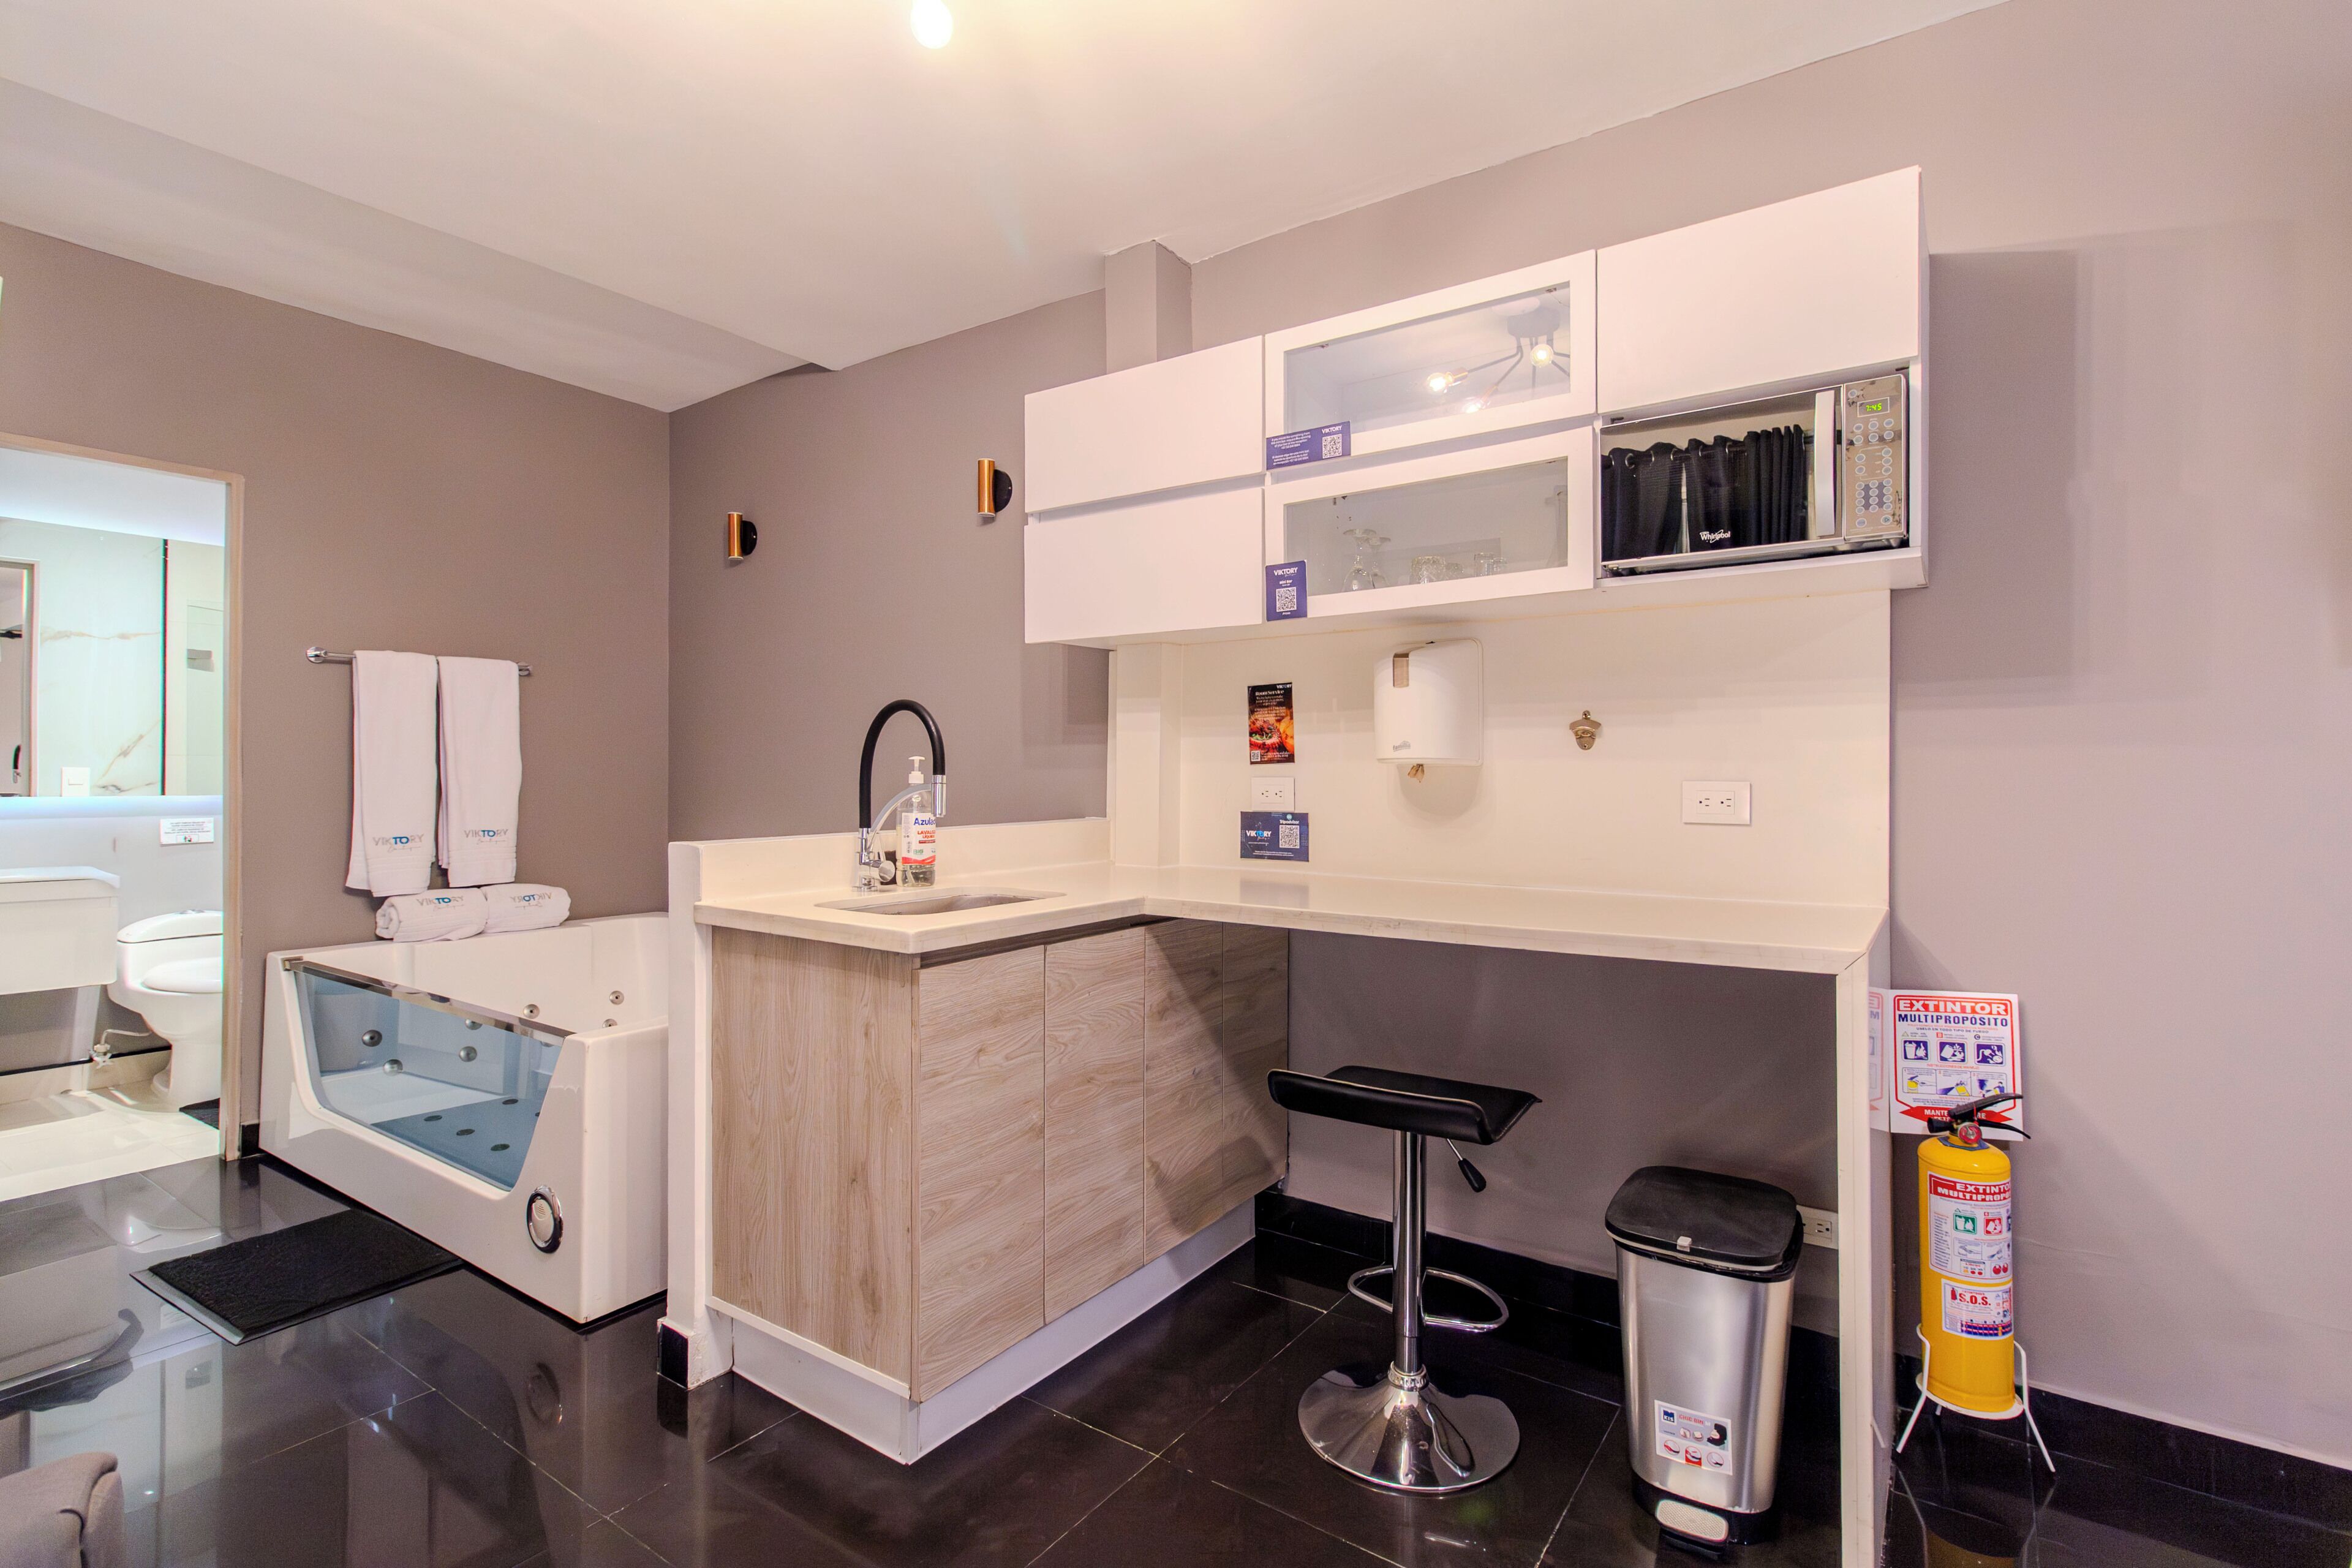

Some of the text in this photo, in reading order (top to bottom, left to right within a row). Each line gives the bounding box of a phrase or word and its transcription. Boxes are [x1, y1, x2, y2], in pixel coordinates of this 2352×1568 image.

[1322, 425, 1342, 434] VIKTORY
[1700, 530, 1730, 541] Whirlpool
[1274, 567, 1298, 576] VIKTORY
[372, 833, 424, 846] VIKTORY
[464, 829, 508, 838] VIKTORY
[1899, 1000, 2007, 1015] EXTINTOR
[1898, 1014, 2008, 1027] MULTIPROPÓSITO
[1937, 1187, 2009, 1201] MULTIPROP
[1956, 1183, 2009, 1193] EXTINTO
[1959, 1293, 1991, 1306] S.O.S.
